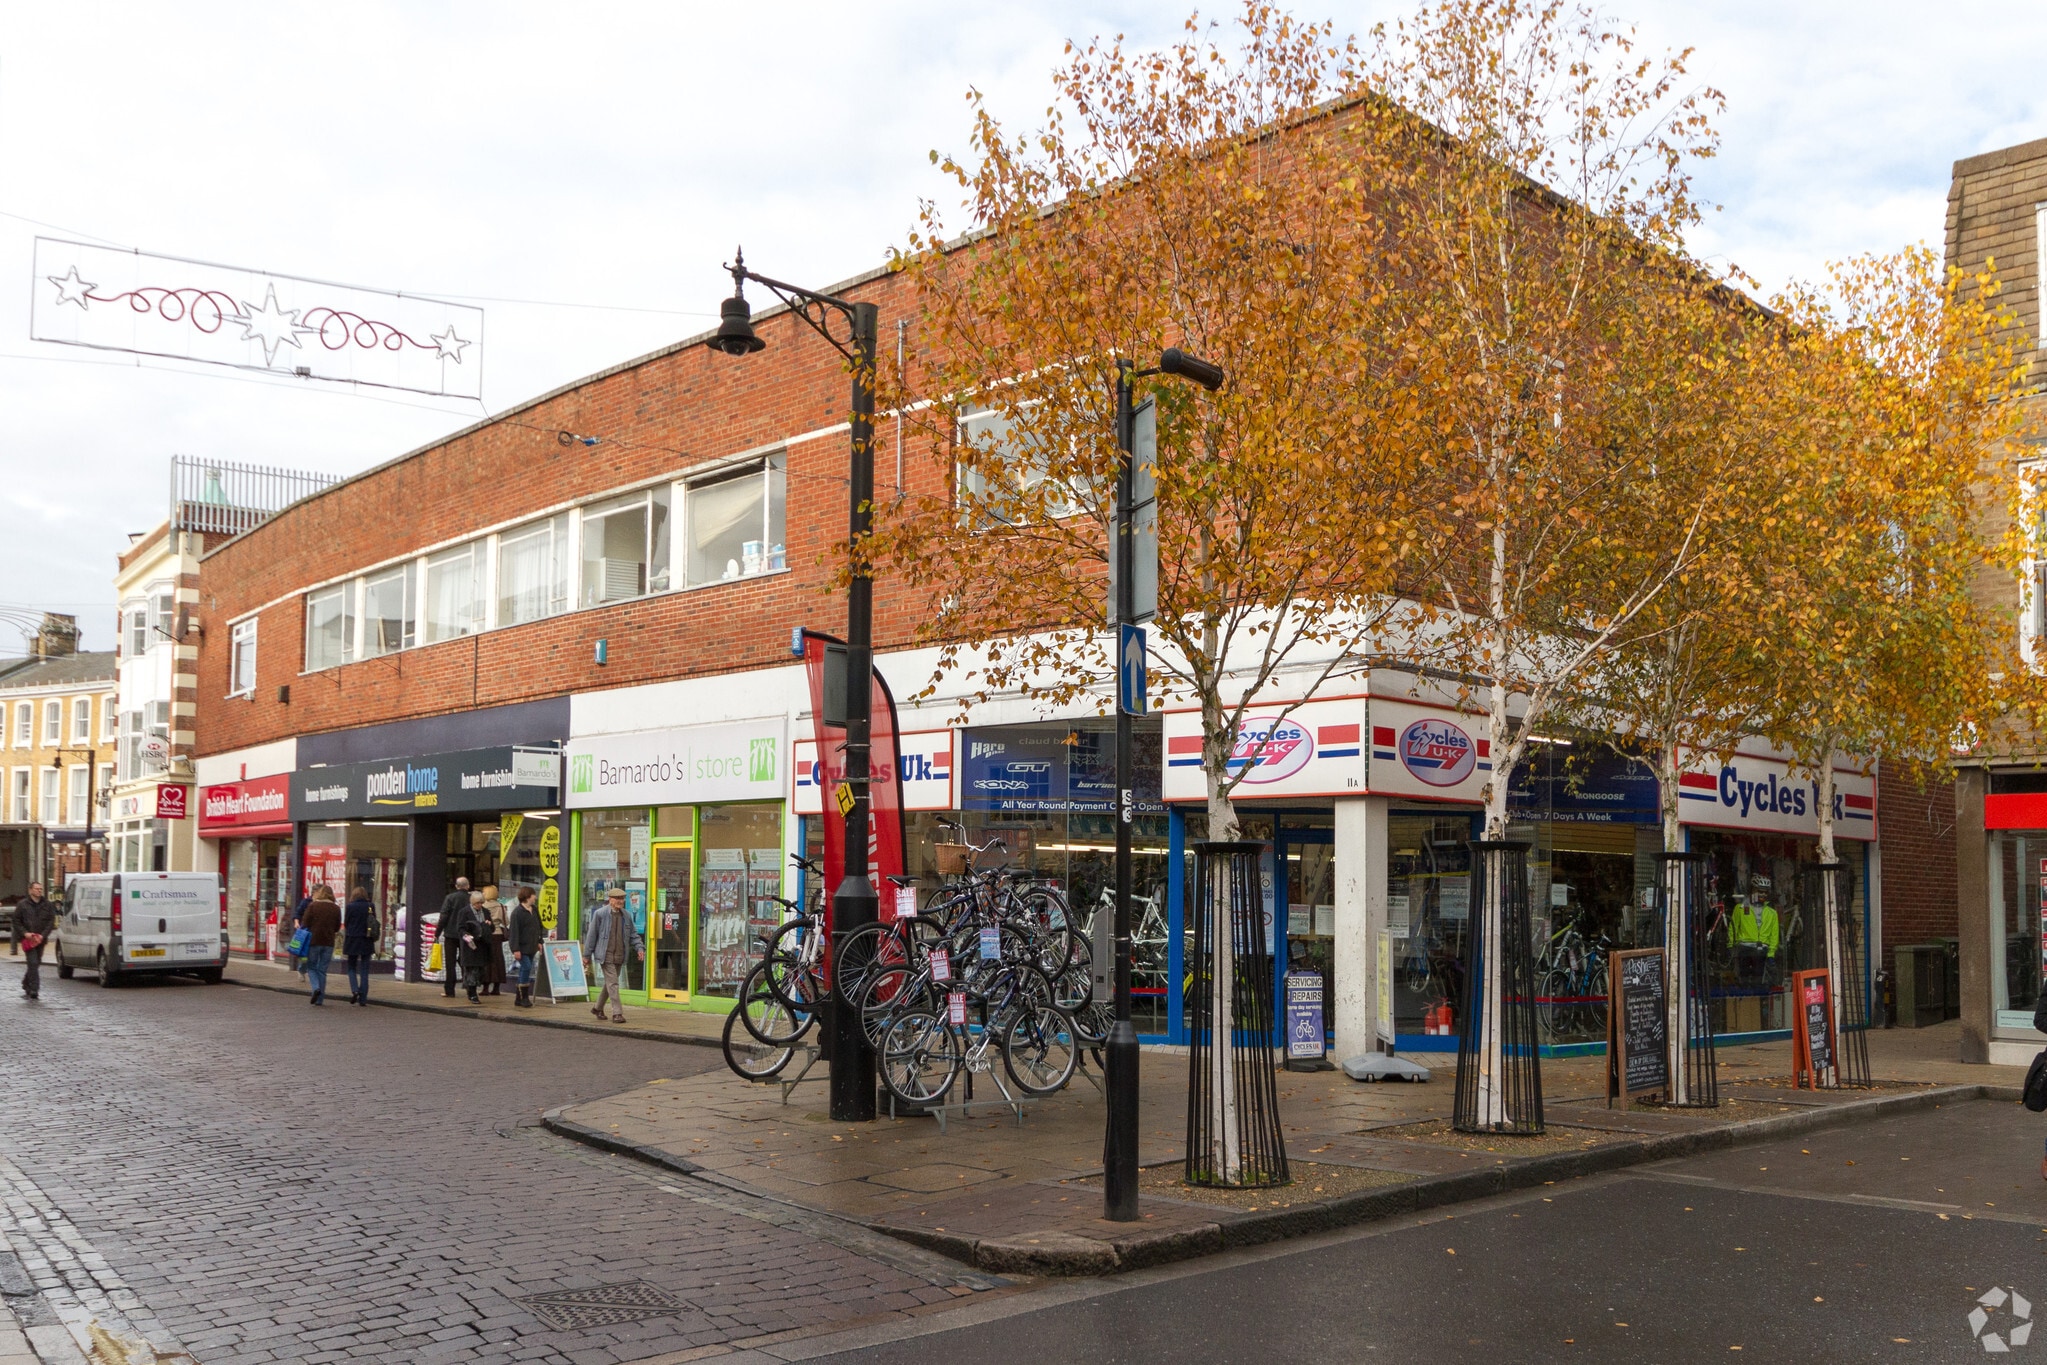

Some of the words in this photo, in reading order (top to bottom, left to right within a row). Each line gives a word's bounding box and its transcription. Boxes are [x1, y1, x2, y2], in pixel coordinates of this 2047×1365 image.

[1019, 737, 1050, 745] claud
[1408, 726, 1467, 748] Cycles
[141, 750, 167, 758] HSBC
[971, 742, 1005, 760] Haro
[517, 768, 556, 778] Barnardo's
[600, 753, 683, 786] Barnardo's
[696, 755, 743, 779] store
[812, 755, 892, 791] Cyes
[901, 754, 932, 781] Uk
[367, 765, 405, 803] ponden
[407, 763, 438, 793] home
[461, 772, 480, 790] home
[973, 779, 1029, 790] KONA
[305, 788, 320, 802] home
[320, 785, 348, 803] furnishings
[1124, 791, 1132, 803] S
[1575, 792, 1625, 801] MONGOOSE
[1719, 765, 1806, 818] Cycles
[206, 795, 225, 818] British
[226, 795, 243, 815] Heart
[244, 788, 284, 813] Foundation
[415, 792, 438, 808] interiors
[1002, 800, 1014, 810] All
[1016, 800, 1036, 810] Year
[1038, 800, 1067, 810] Round
[1069, 801, 1106, 812] Payment
[1138, 802, 1163, 813] Open
[1124, 809, 1132, 821] 3
[1525, 810, 1541, 821] Open
[1544, 812, 1549, 820] 7
[1553, 812, 1575, 822] Days
[1577, 812, 1585, 821] A
[1587, 812, 1612, 822] Week
[546, 832, 559, 841] Quilt
[142, 889, 198, 899] Craftsmans
[896, 888, 914, 897] SALE
[930, 951, 947, 961] SALE
[1287, 977, 1322, 987] SERVICING
[949, 994, 964, 1003] SALE
[1292, 991, 1322, 1001] REPAIRS
[1293, 1043, 1313, 1051] CYCLES
